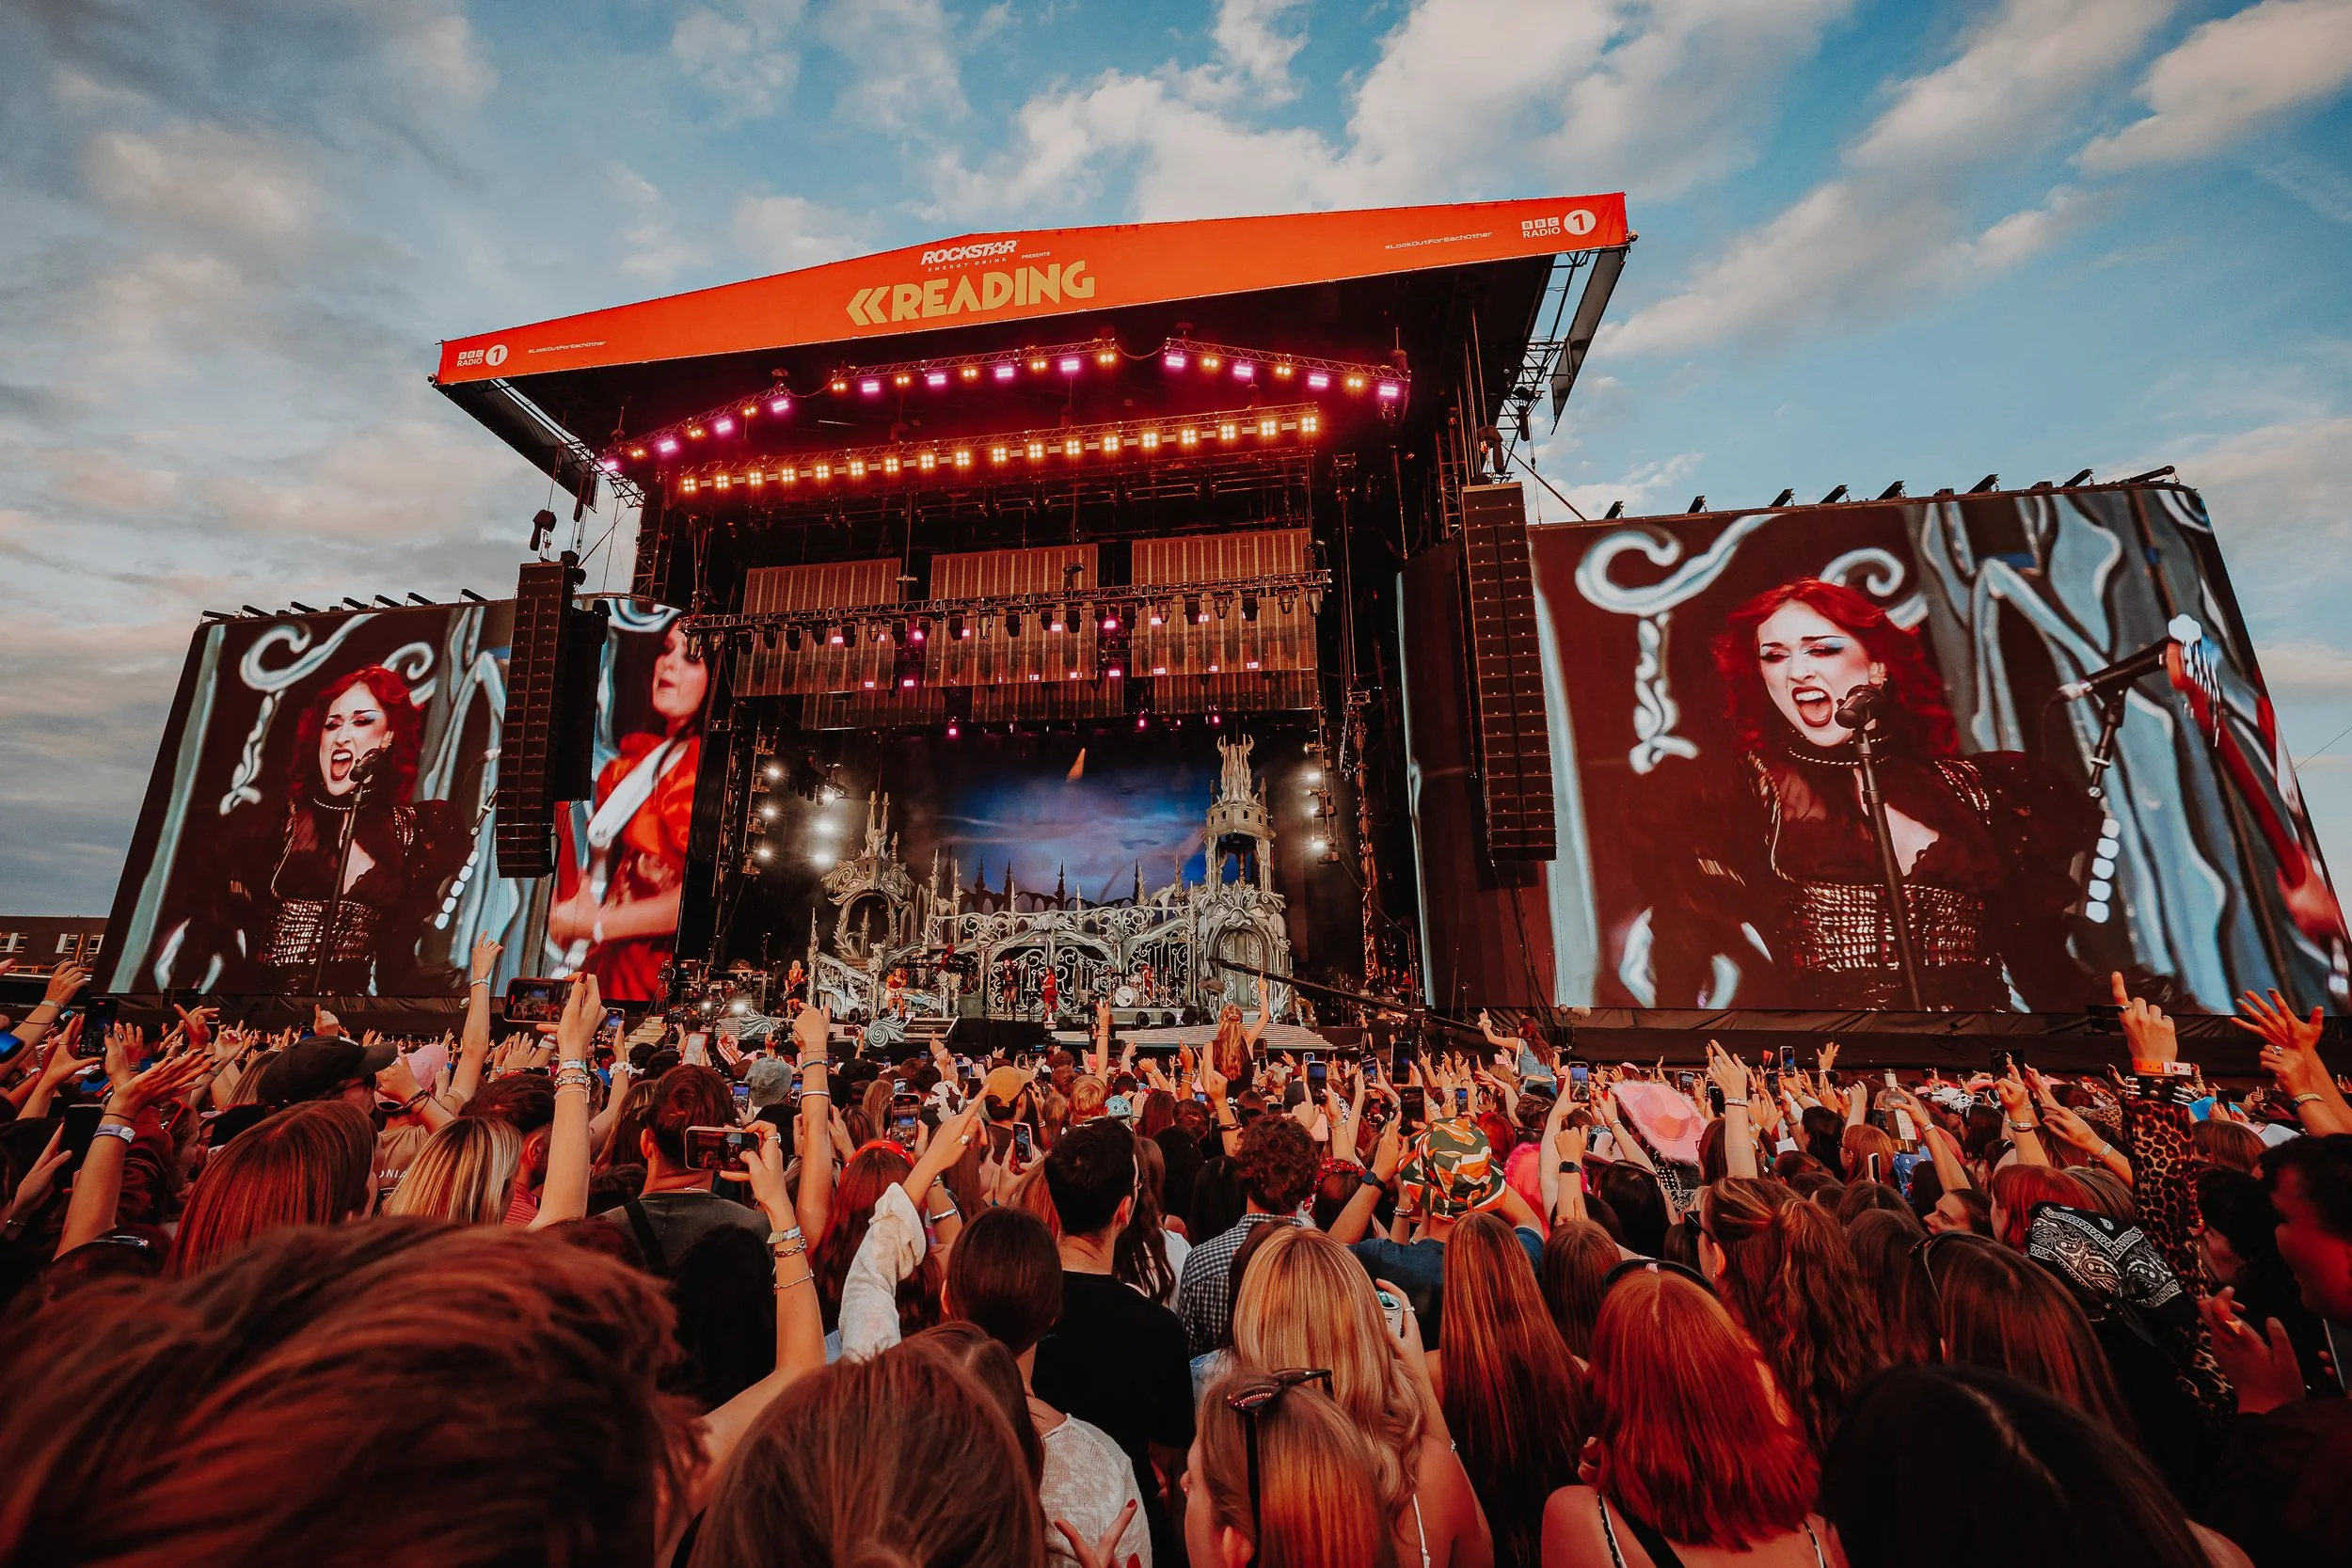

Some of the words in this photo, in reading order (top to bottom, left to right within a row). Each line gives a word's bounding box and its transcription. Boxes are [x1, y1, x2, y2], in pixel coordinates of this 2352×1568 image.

[1522, 217, 1558, 230] BBC
[1522, 227, 1561, 239] RADIO
[1385, 231, 1493, 250] #LookOutForEachOther
[920, 239, 1019, 265] ROCKSTAR
[1021, 251, 1051, 260] PRESENTS
[928, 261, 969, 273] ENERGY
[975, 257, 1008, 266] DRINK
[891, 261, 1095, 322] READING
[528, 341, 607, 354] #LookOutForEachOther
[456, 357, 484, 367] RADIO
